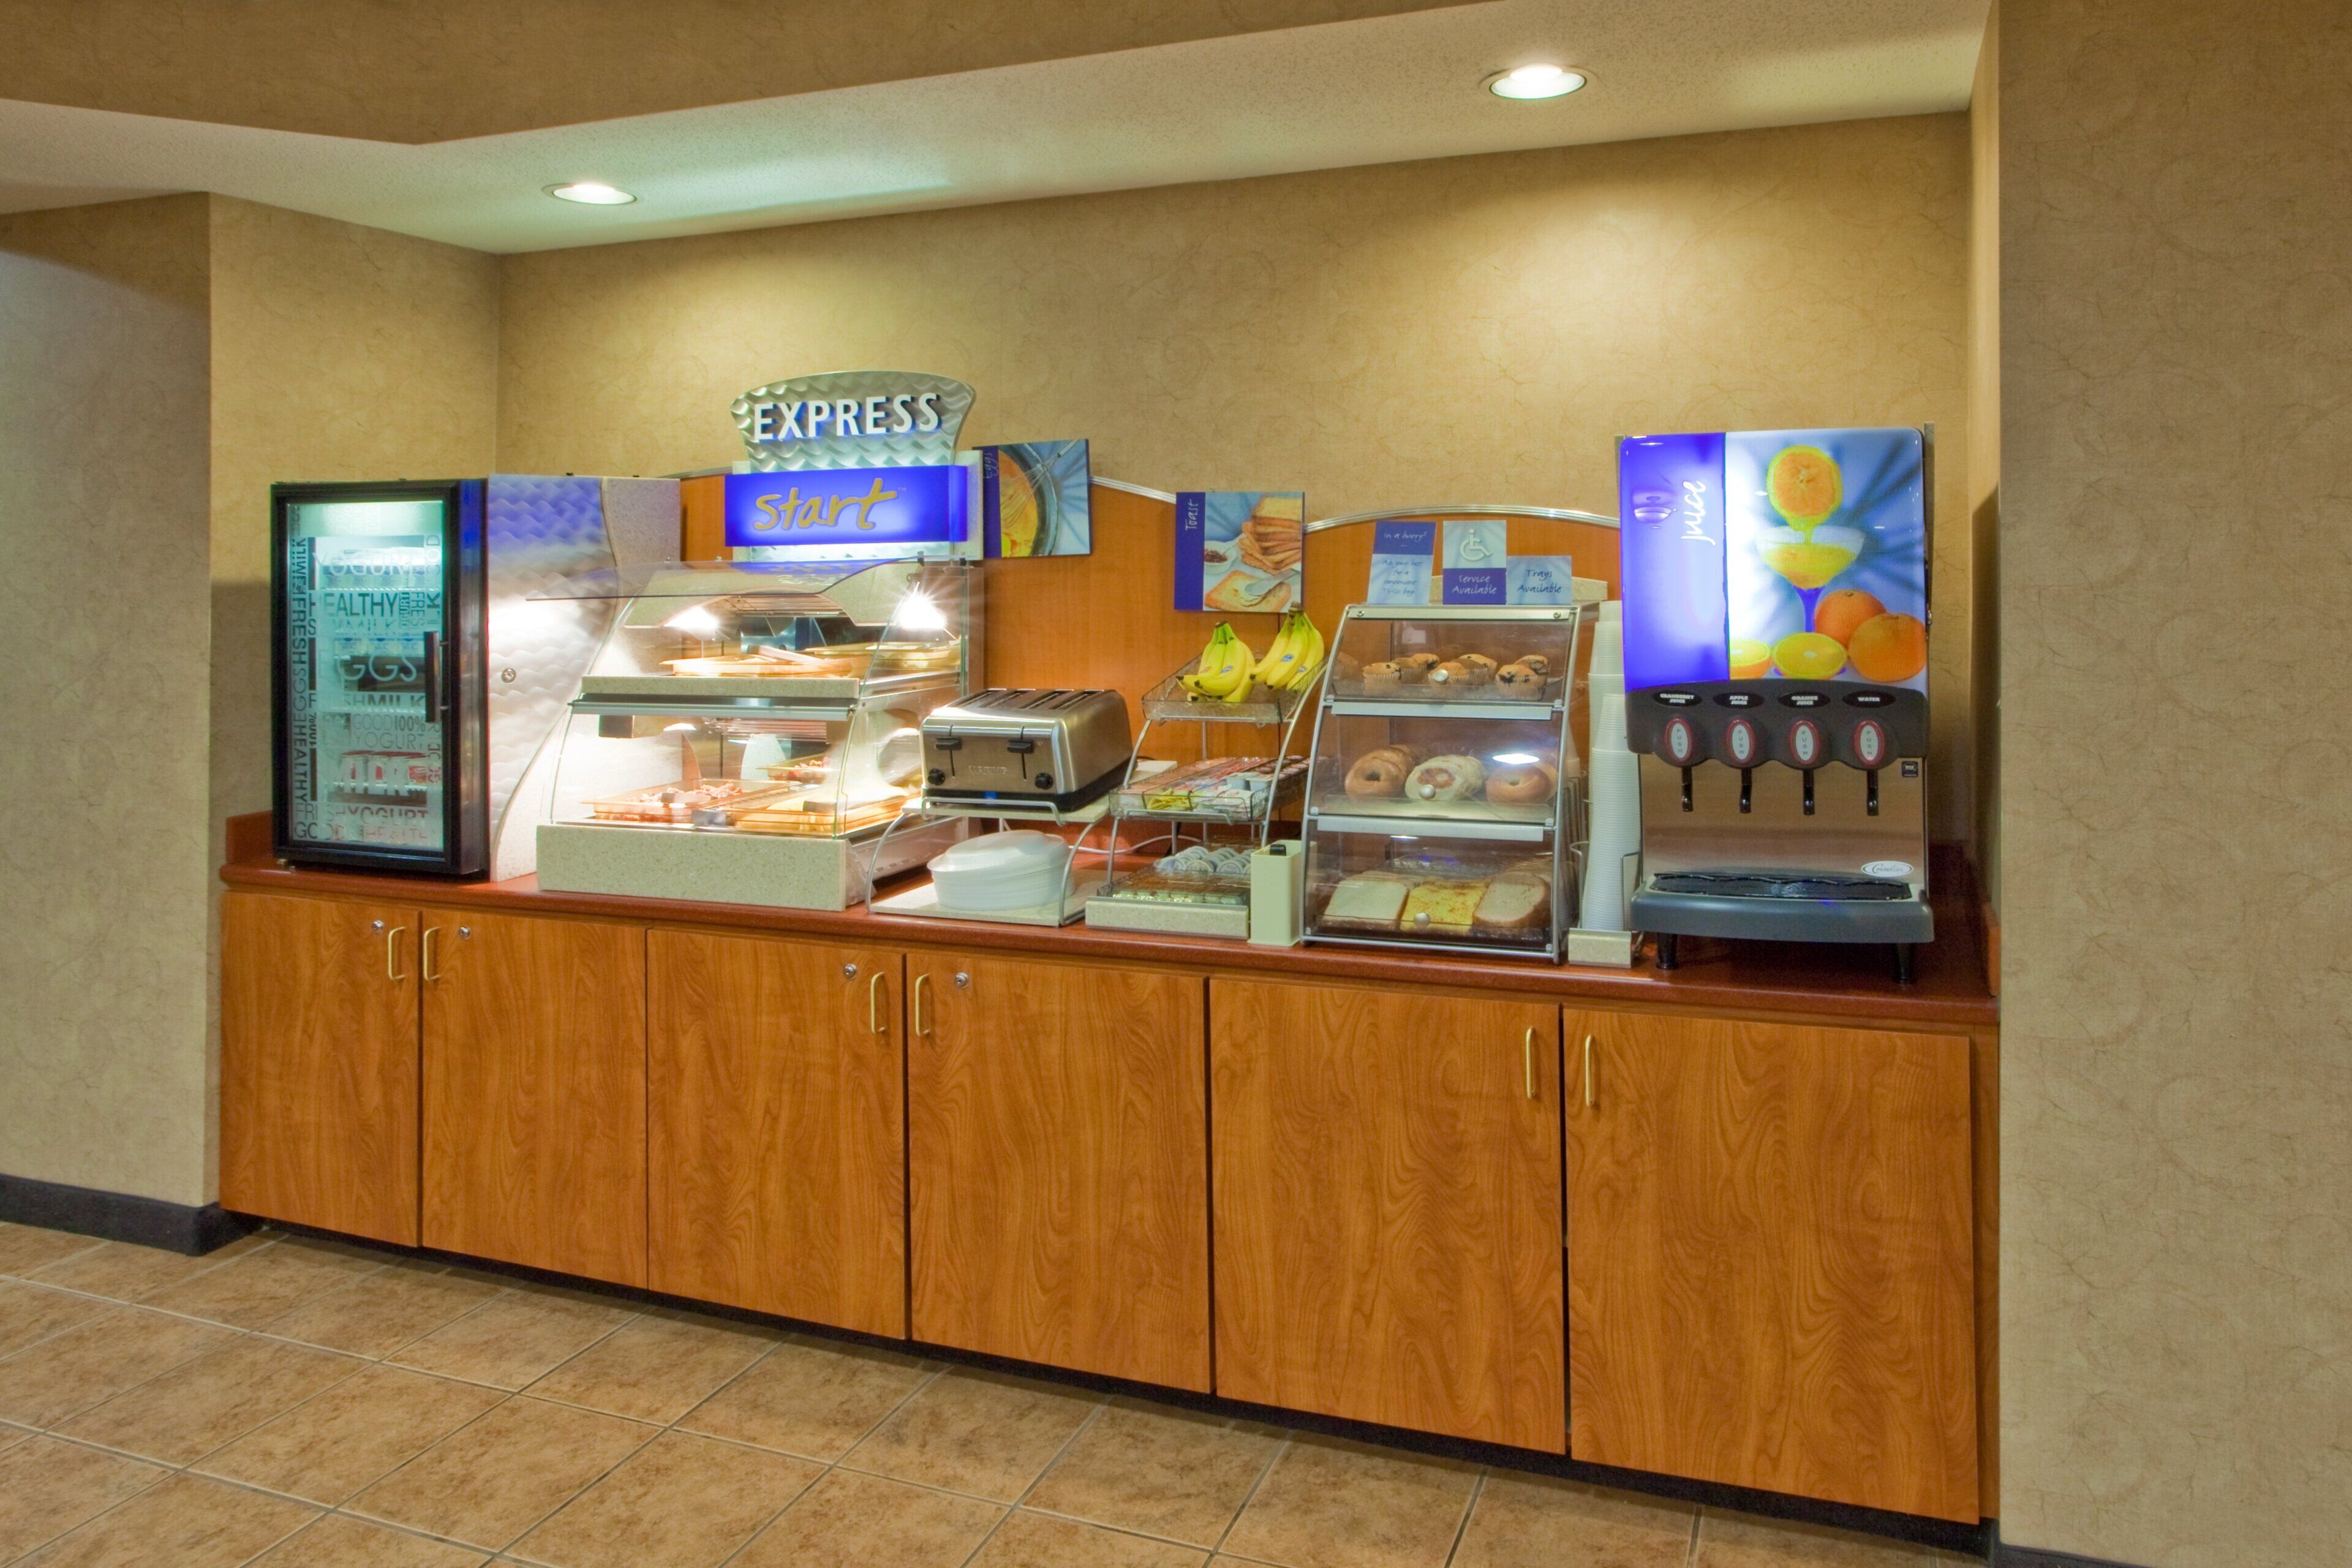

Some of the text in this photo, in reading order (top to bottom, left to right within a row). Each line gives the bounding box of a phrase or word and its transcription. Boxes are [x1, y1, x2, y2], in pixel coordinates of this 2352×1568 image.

[754, 392, 940, 441] EXPRESS
[753, 477, 899, 531] start
[1185, 499, 1199, 530] Toast
[1452, 583, 1498, 594] Available
[1517, 582, 1562, 594] Available
[1526, 569, 1552, 581] Trays
[293, 597, 306, 665] FRESH
[294, 725, 307, 804] HEALTHY
